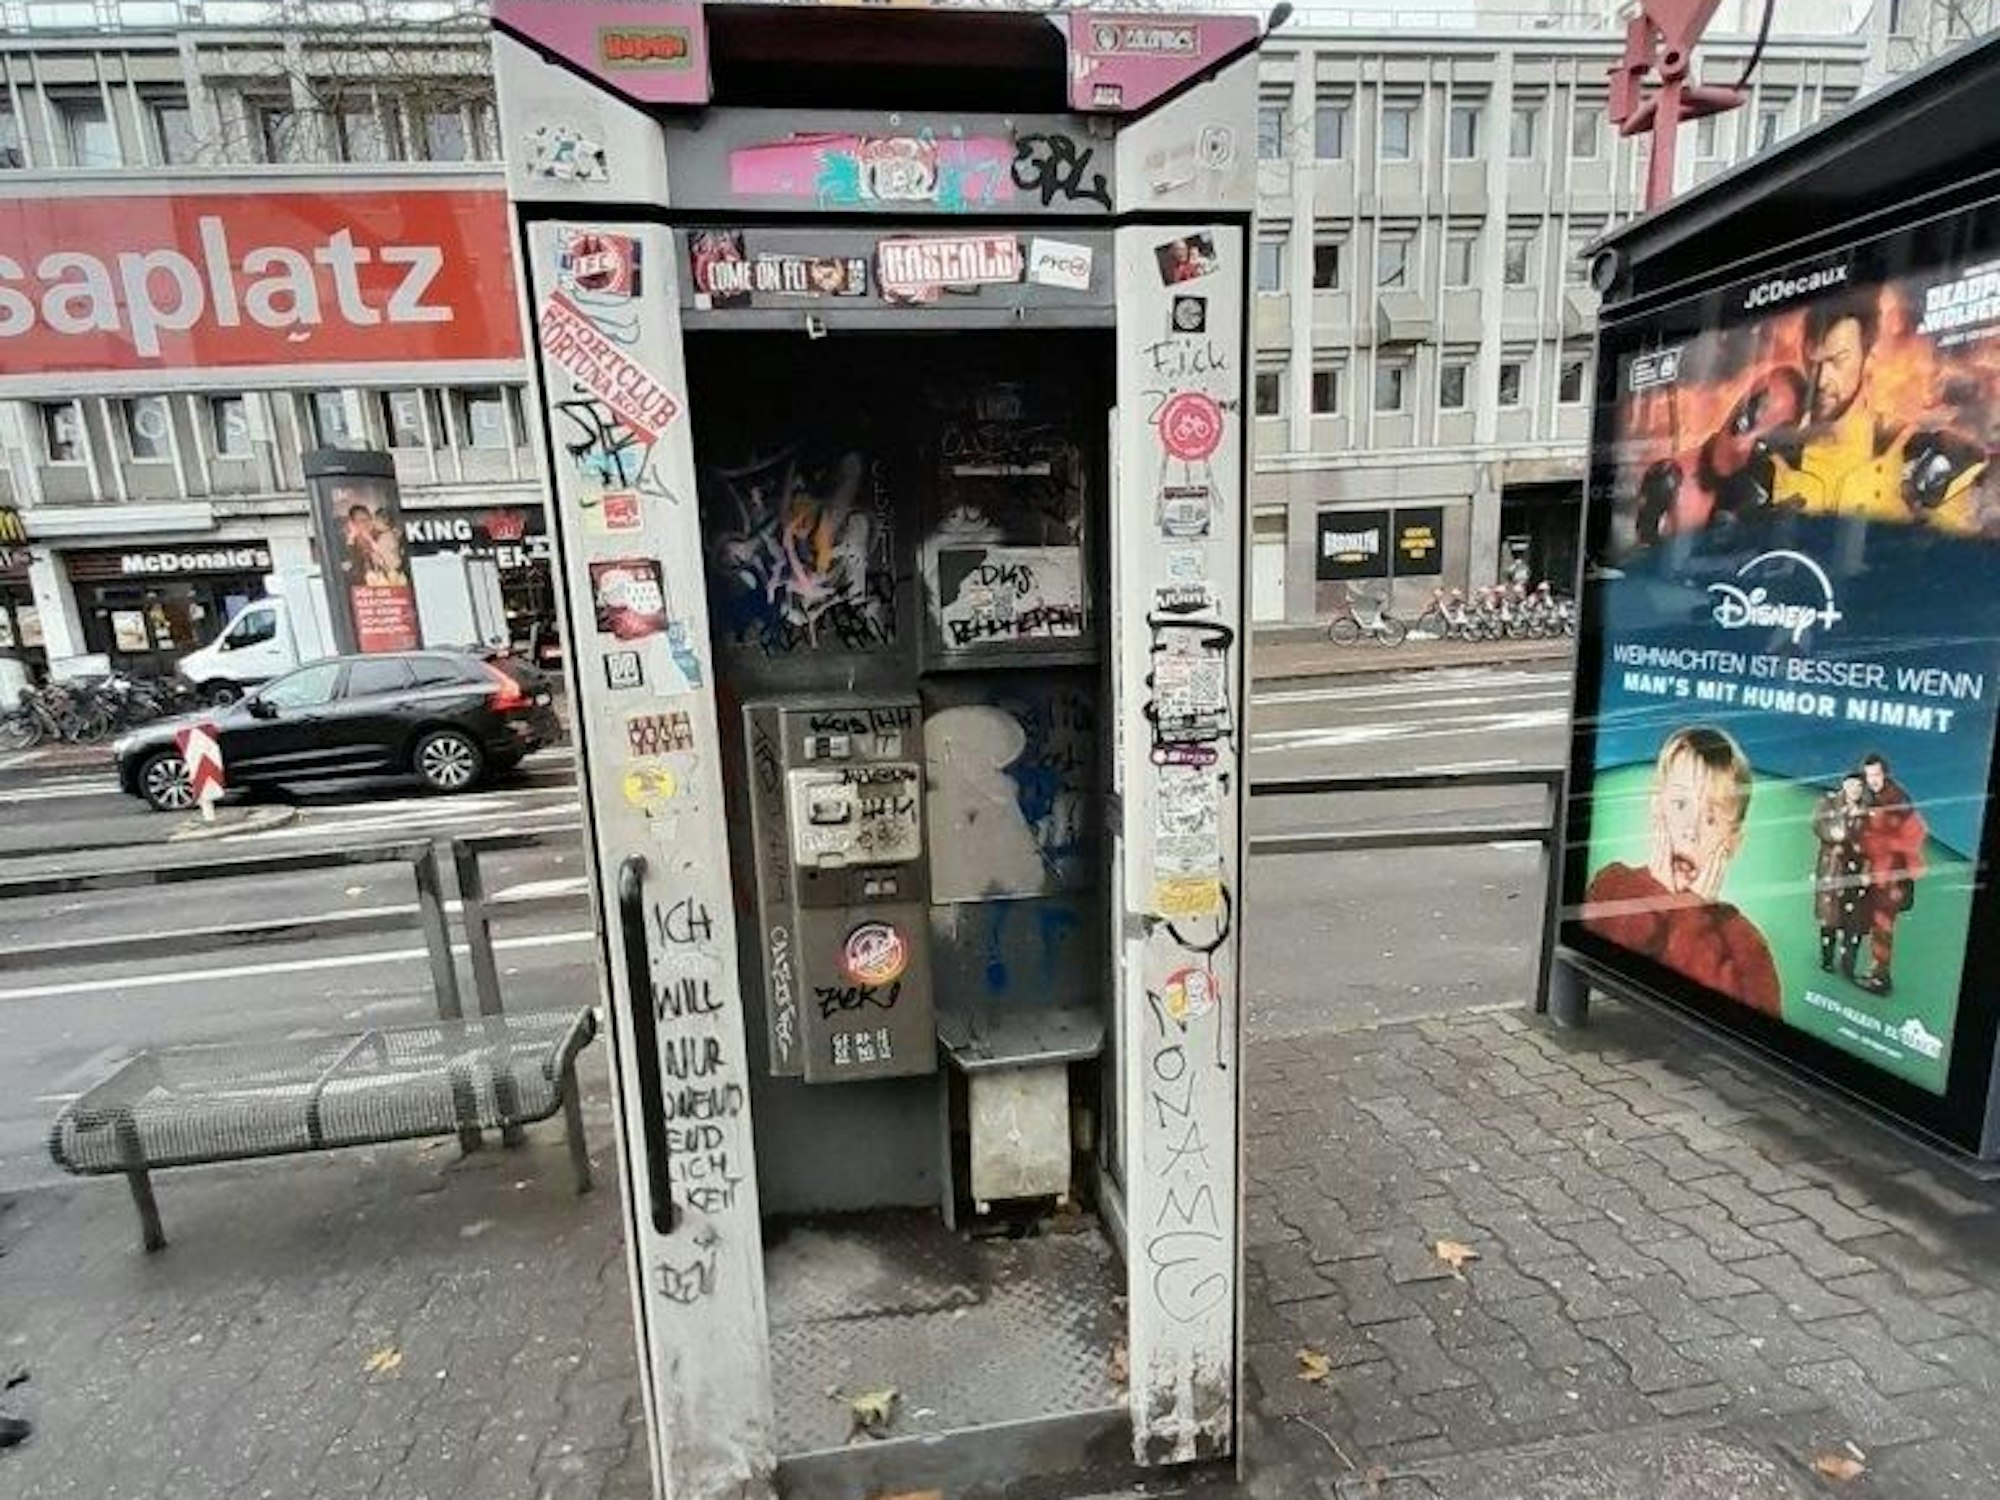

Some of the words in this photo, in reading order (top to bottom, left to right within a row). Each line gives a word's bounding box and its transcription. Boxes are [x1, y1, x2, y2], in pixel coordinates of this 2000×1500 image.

[707, 261, 750, 291] COME
[755, 261, 780, 291] ON
[1744, 264, 1849, 309] JCDecaux
[552, 303, 677, 427] SPORTCLUB
[404, 519, 473, 542] KING
[120, 547, 271, 574] McDonald's
[1706, 582, 1842, 644] Disney+
[1612, 643, 1747, 675] WEIHNACHTEN
[1750, 654, 1780, 679] IST
[1896, 667, 1984, 701] WENN
[1623, 671, 1690, 697] MAN'S
[1697, 680, 1738, 703] MIT
[1741, 684, 1836, 718] HUMOR
[1845, 697, 1955, 734] NIMMT
[655, 896, 713, 948] ICH
[652, 976, 724, 1023] WILL
